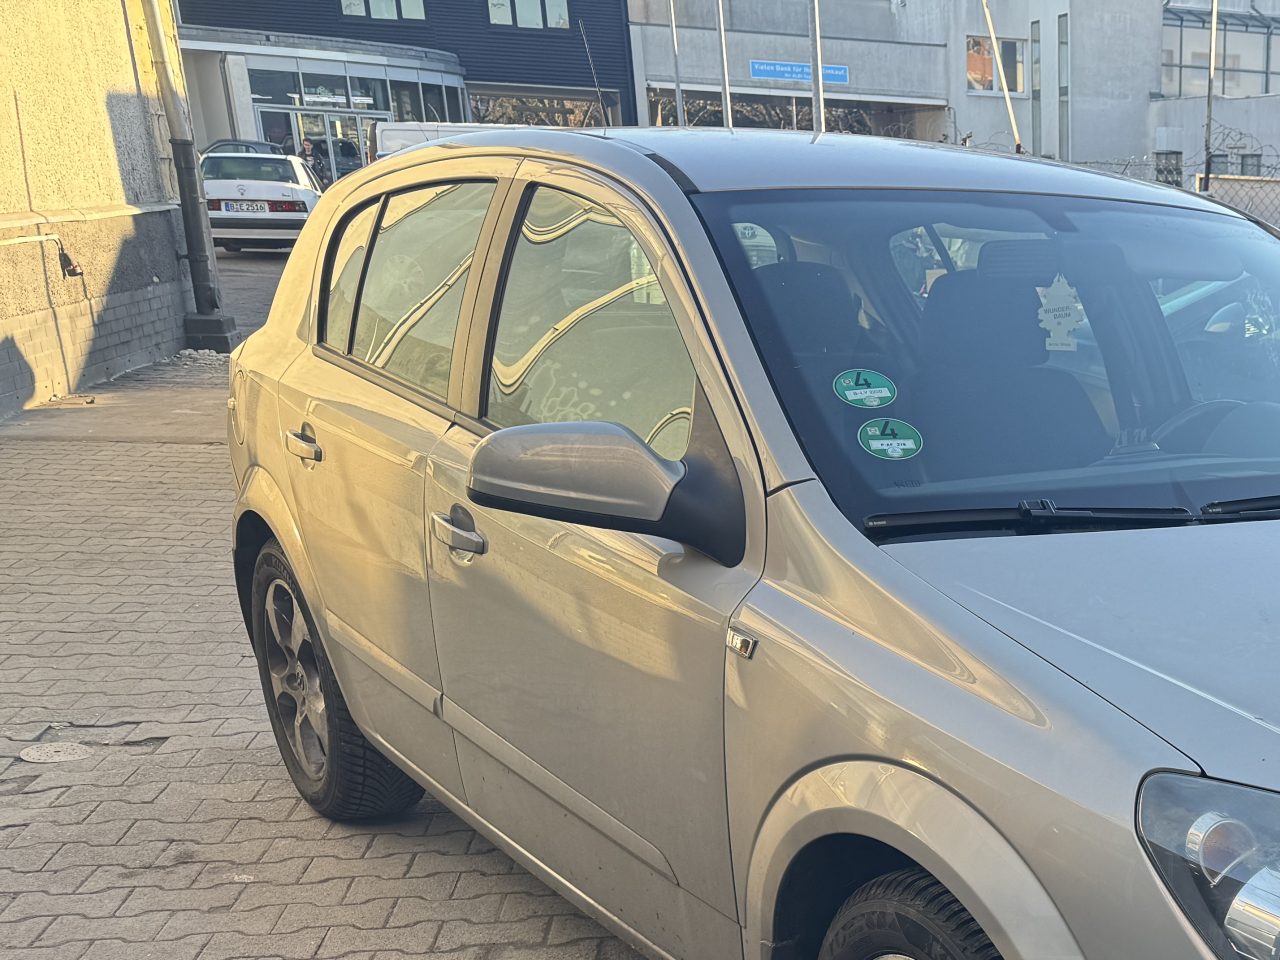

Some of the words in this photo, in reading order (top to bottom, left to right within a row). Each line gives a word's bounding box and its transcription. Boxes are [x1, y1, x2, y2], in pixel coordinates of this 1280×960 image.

[754, 63, 774, 71] Vielen
[775, 64, 791, 72] Dank
[792, 65, 803, 73] für
[855, 372, 871, 388] 4
[881, 421, 898, 438] 4
